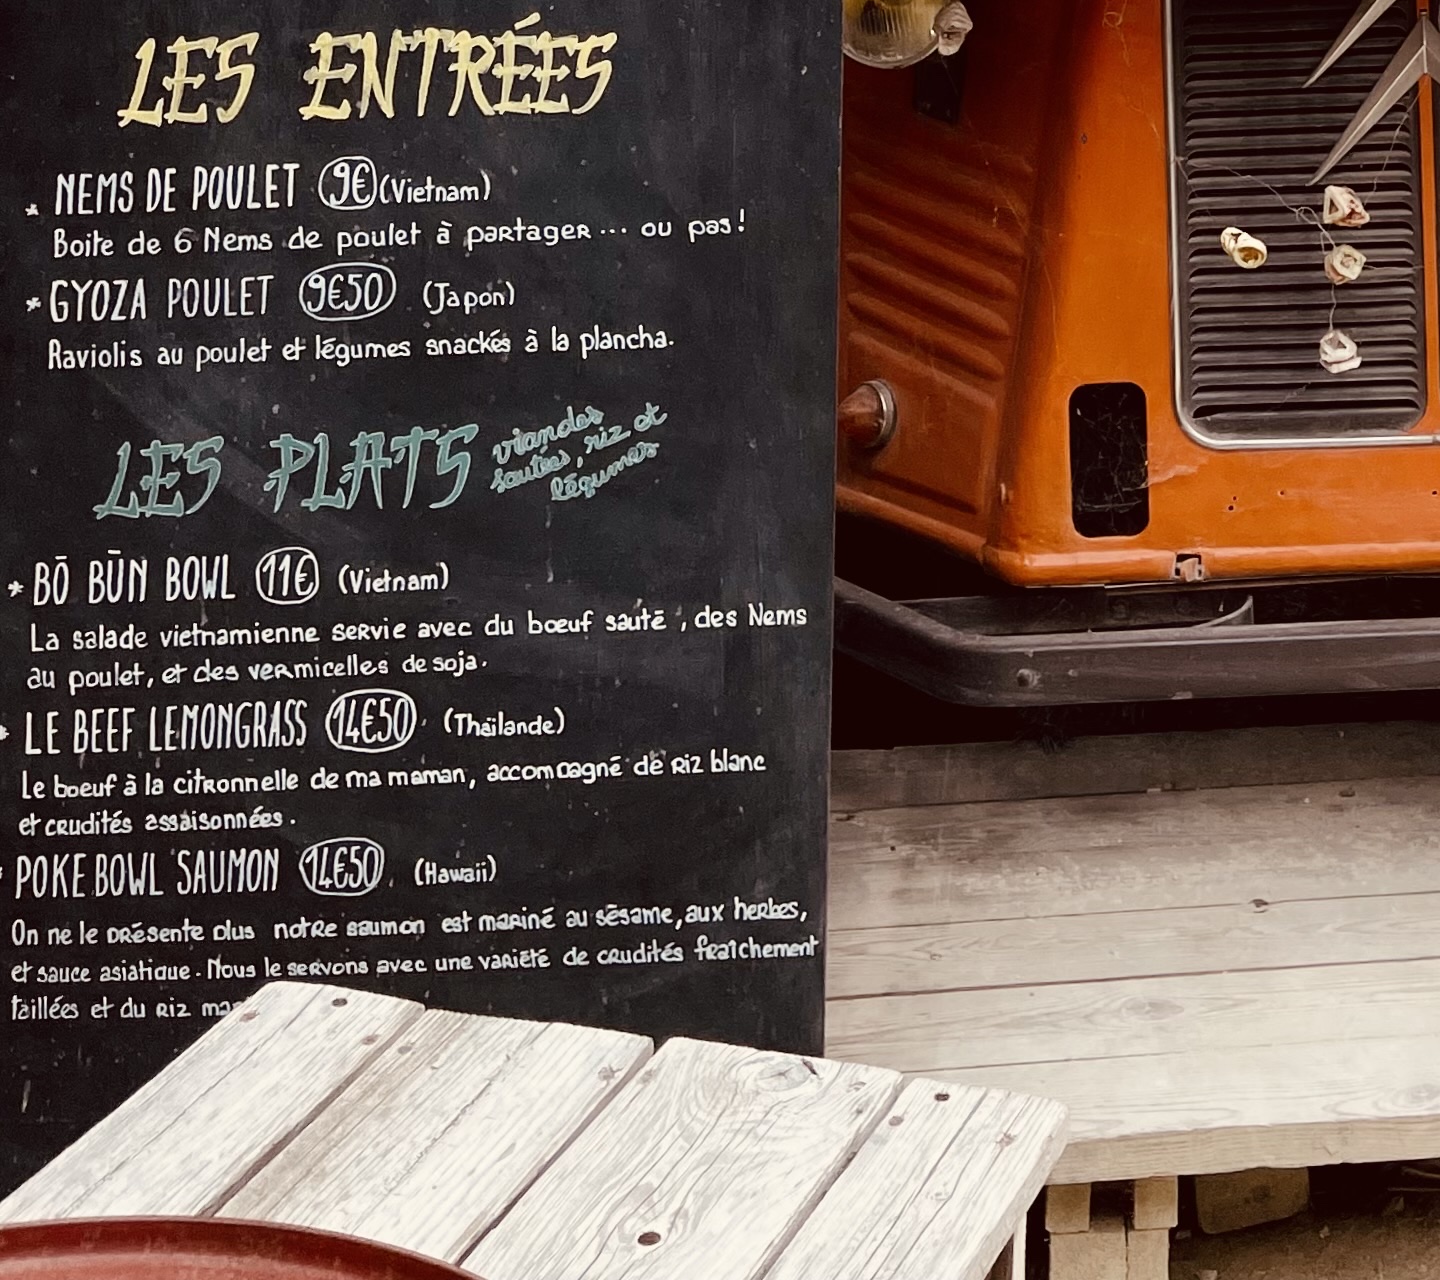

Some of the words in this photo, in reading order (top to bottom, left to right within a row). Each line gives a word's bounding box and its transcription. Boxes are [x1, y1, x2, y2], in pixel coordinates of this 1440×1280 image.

[116, 31, 260, 128] LES
[298, 12, 618, 121] ENTRÉES
[54, 170, 134, 216] NEMS
[146, 167, 177, 213] DE
[192, 162, 300, 211] POULET
[329, 163, 371, 206] 9€
[379, 171, 491, 204] (Vietnam)
[53, 228, 114, 259] Boite
[127, 230, 162, 256] de
[174, 227, 193, 254] 6
[203, 226, 273, 253] Nems
[287, 225, 323, 250] de
[337, 221, 422, 256] poulet
[436, 220, 453, 245] à
[641, 221, 672, 237] ou
[49, 278, 147, 323] GYOZA
[167, 274, 275, 319] POULET
[306, 273, 390, 313] 9€50
[422, 280, 515, 315] (Japon)
[48, 338, 143, 370] Raviolis
[157, 346, 183, 366] au
[195, 337, 273, 373] poulet
[281, 336, 307, 361] et
[315, 334, 411, 367] légumes
[425, 328, 511, 356] snackés
[524, 328, 539, 353] à
[551, 325, 570, 352] la
[579, 324, 675, 360] plancha.
[493, 406, 604, 464] viandes
[584, 426, 631, 454] riz
[92, 435, 225, 521] LES
[262, 423, 480, 514] PLATS
[551, 442, 660, 501] légumes
[165, 553, 236, 602] BOWL
[262, 551, 315, 596] 11€
[338, 561, 449, 595] (Vietnam)
[30, 622, 60, 652] La
[72, 623, 149, 650] salade
[159, 621, 321, 648] vietnamienne
[417, 621, 473, 638] avec
[484, 613, 514, 636] du
[694, 604, 738, 629] des
[747, 602, 807, 627] Nems
[26, 667, 56, 690] au
[68, 661, 154, 696] poulet,
[161, 663, 188, 684] et
[193, 658, 240, 683] des
[401, 653, 428, 673] de
[25, 710, 61, 755] LE
[73, 707, 136, 754] BEEF
[149, 698, 308, 752] LEMONGRASS
[329, 696, 410, 746] 14€50
[443, 706, 565, 737] (Thaïlande)
[15, 852, 87, 900] POKE
[95, 851, 164, 897] BOWL
[176, 847, 279, 895] SAUMON
[302, 844, 380, 887] 14€50
[414, 853, 497, 886] (Hawaii)
